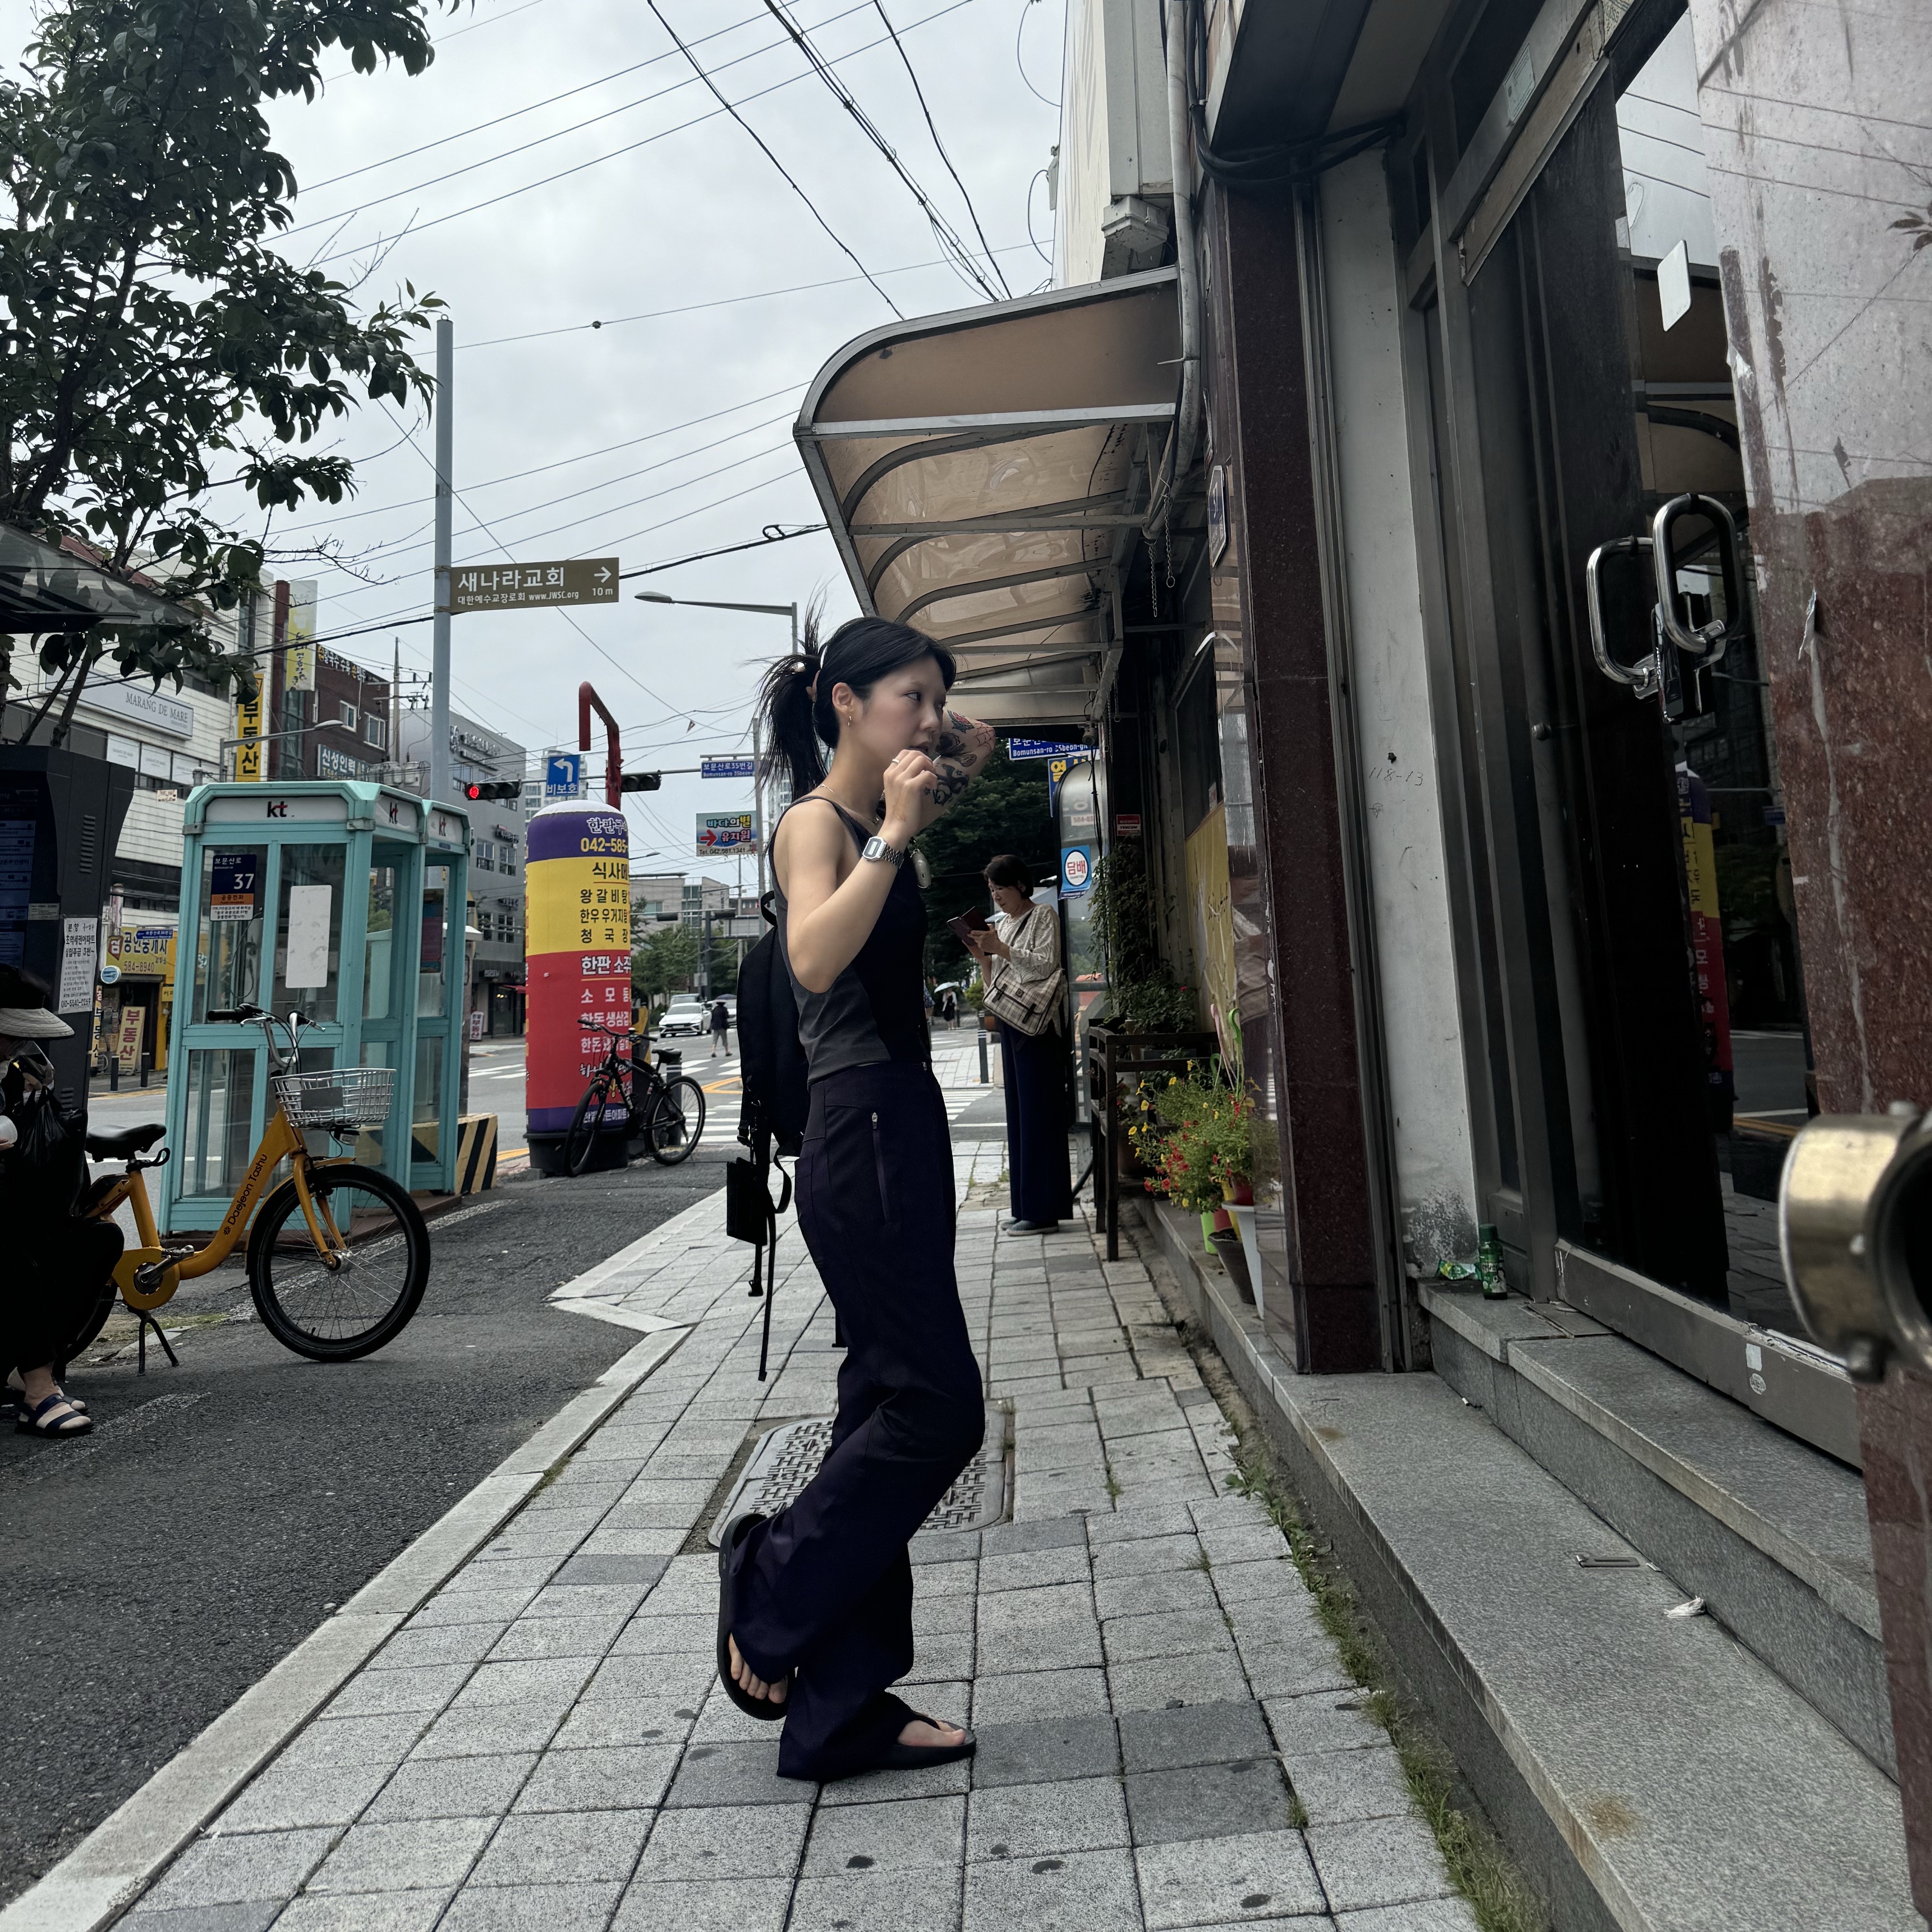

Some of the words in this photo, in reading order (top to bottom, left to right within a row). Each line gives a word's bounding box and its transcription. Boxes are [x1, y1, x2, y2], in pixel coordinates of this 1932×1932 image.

[458, 567, 564, 592] 새나라교회
[458, 593, 526, 605] 대한예수교장로회
[529, 590, 579, 601] www.JWSC.org
[126, 692, 156, 712] MARANG
[159, 704, 168, 716] DE
[170, 708, 188, 723] MARE
[242, 701, 258, 774] 부동산
[1013, 747, 1052, 757] Bomunsan-ro
[323, 749, 355, 776] 신성인력
[703, 762, 753, 771] 보문산로35번길
[547, 783, 577, 796] 비보호
[267, 801, 288, 817] kt
[389, 802, 398, 824] kt
[439, 816, 446, 837] kt
[707, 814, 751, 828] 바다의별
[721, 829, 751, 842] 유치원
[1067, 860, 1086, 874] 담배
[234, 874, 254, 889] 37
[580, 909, 599, 923] 한우
[124, 961, 154, 972] 584-8940
[581, 956, 612, 976] 한판
[120, 1010, 140, 1060] 부동산
[581, 1037, 601, 1053] 한돈
[227, 1183, 254, 1225] Daejeon
[249, 1154, 267, 1181] Tashu
